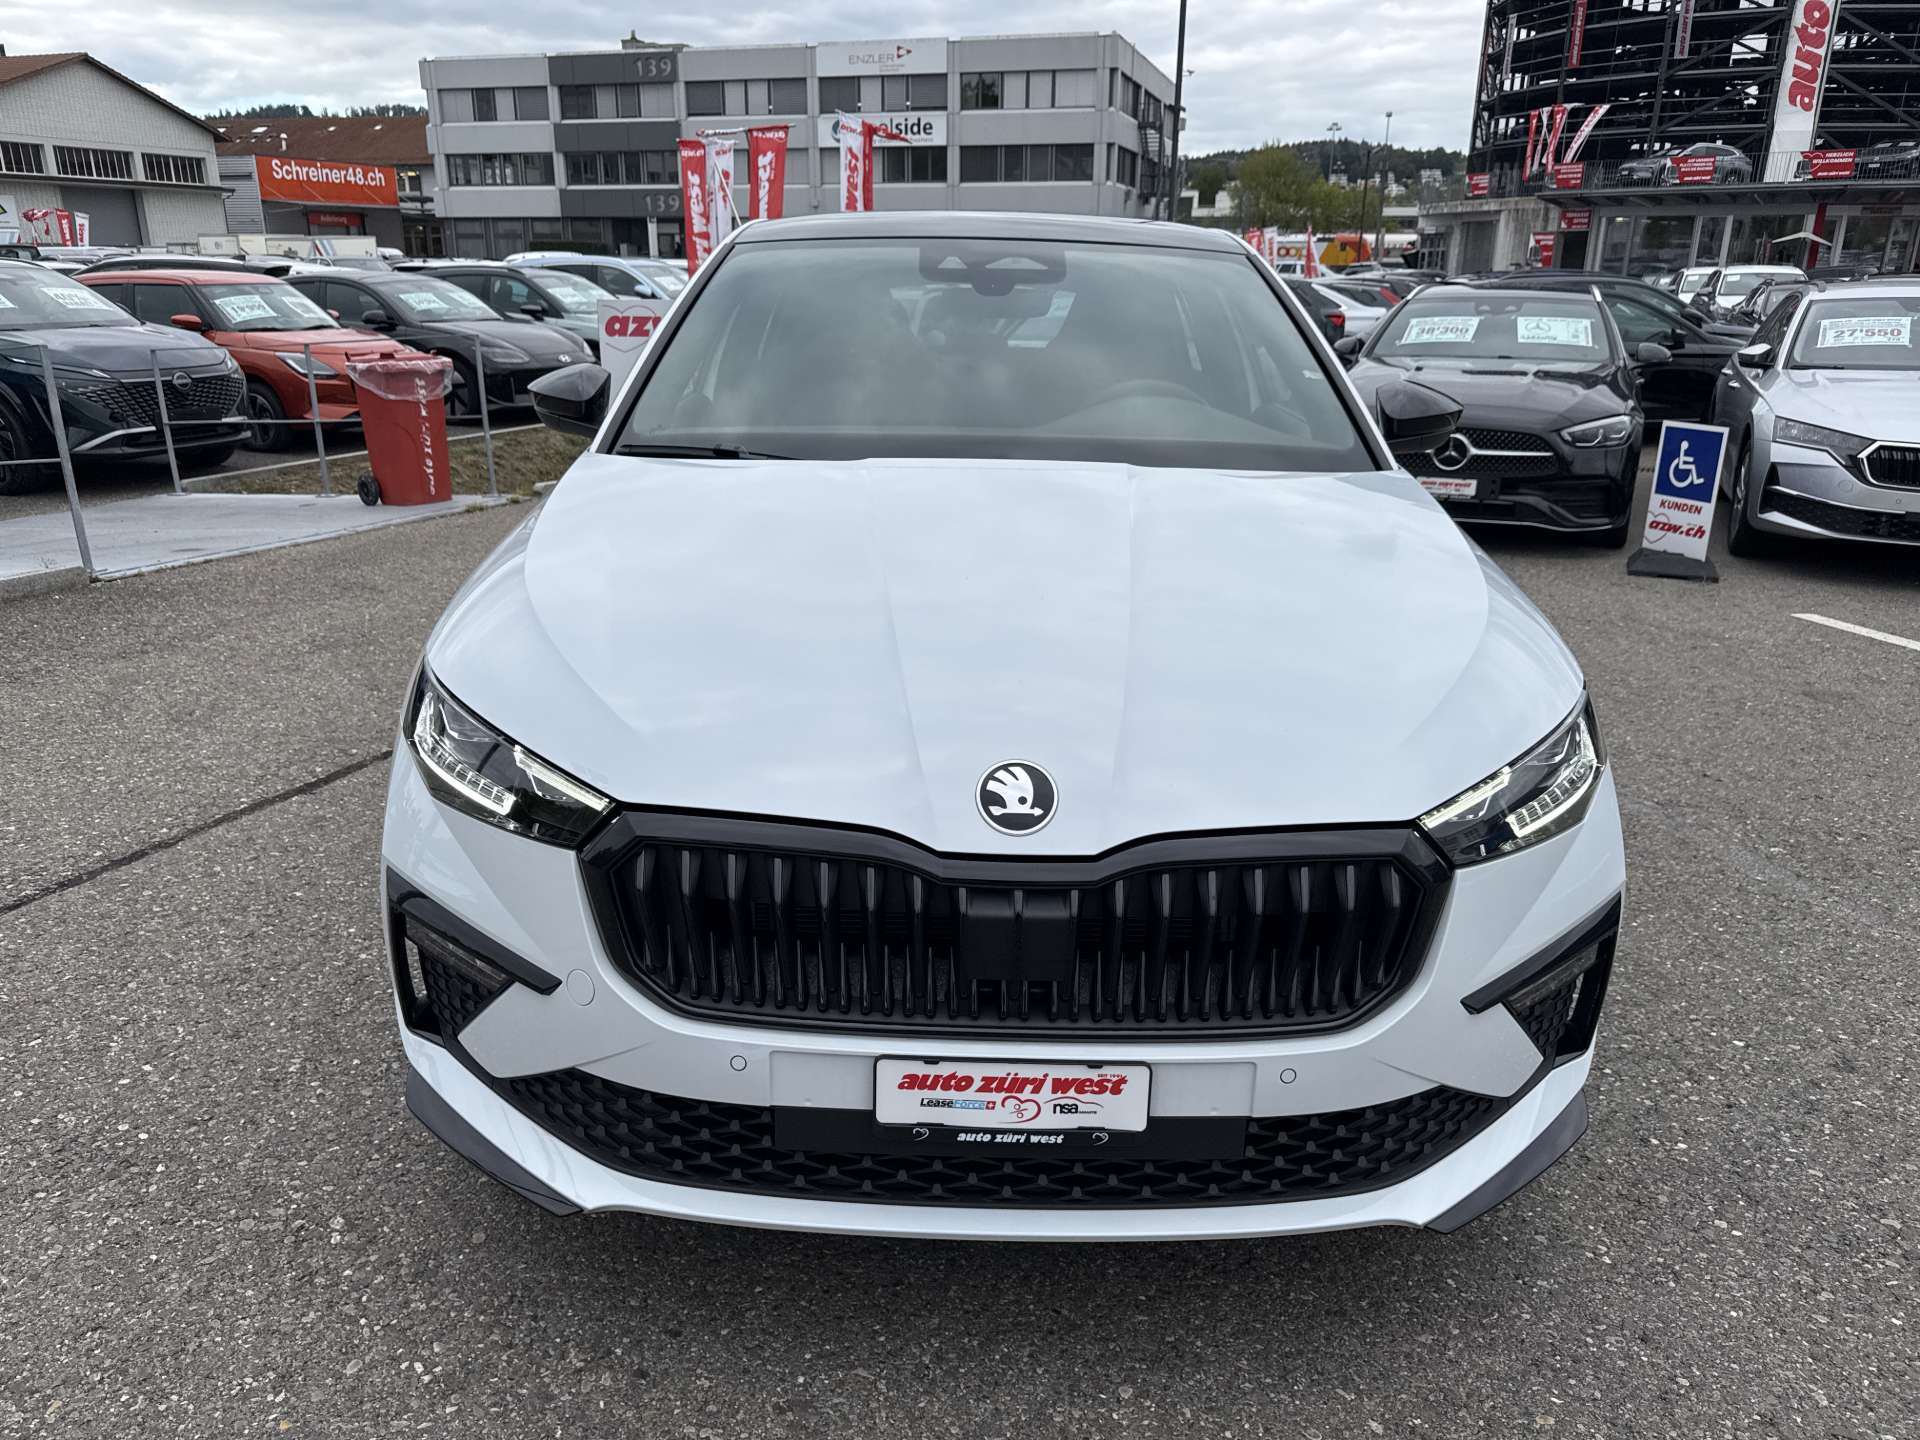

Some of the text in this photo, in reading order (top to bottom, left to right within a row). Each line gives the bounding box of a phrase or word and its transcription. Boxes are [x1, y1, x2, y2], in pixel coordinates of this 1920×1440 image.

[848, 53, 895, 65] ENZLER
[1788, 0, 1830, 112] auto
[636, 58, 672, 77] 139
[271, 158, 386, 187] Schreiner48.ch
[645, 194, 680, 212] 139
[1832, 328, 1902, 338] 27'550
[1659, 499, 1703, 515] KUNDEN
[1648, 520, 1706, 539] azw.ch
[897, 1071, 1129, 1096] auto züri west
[1052, 1103, 1079, 1114] nsa
[956, 1132, 1065, 1144] auto züri west
